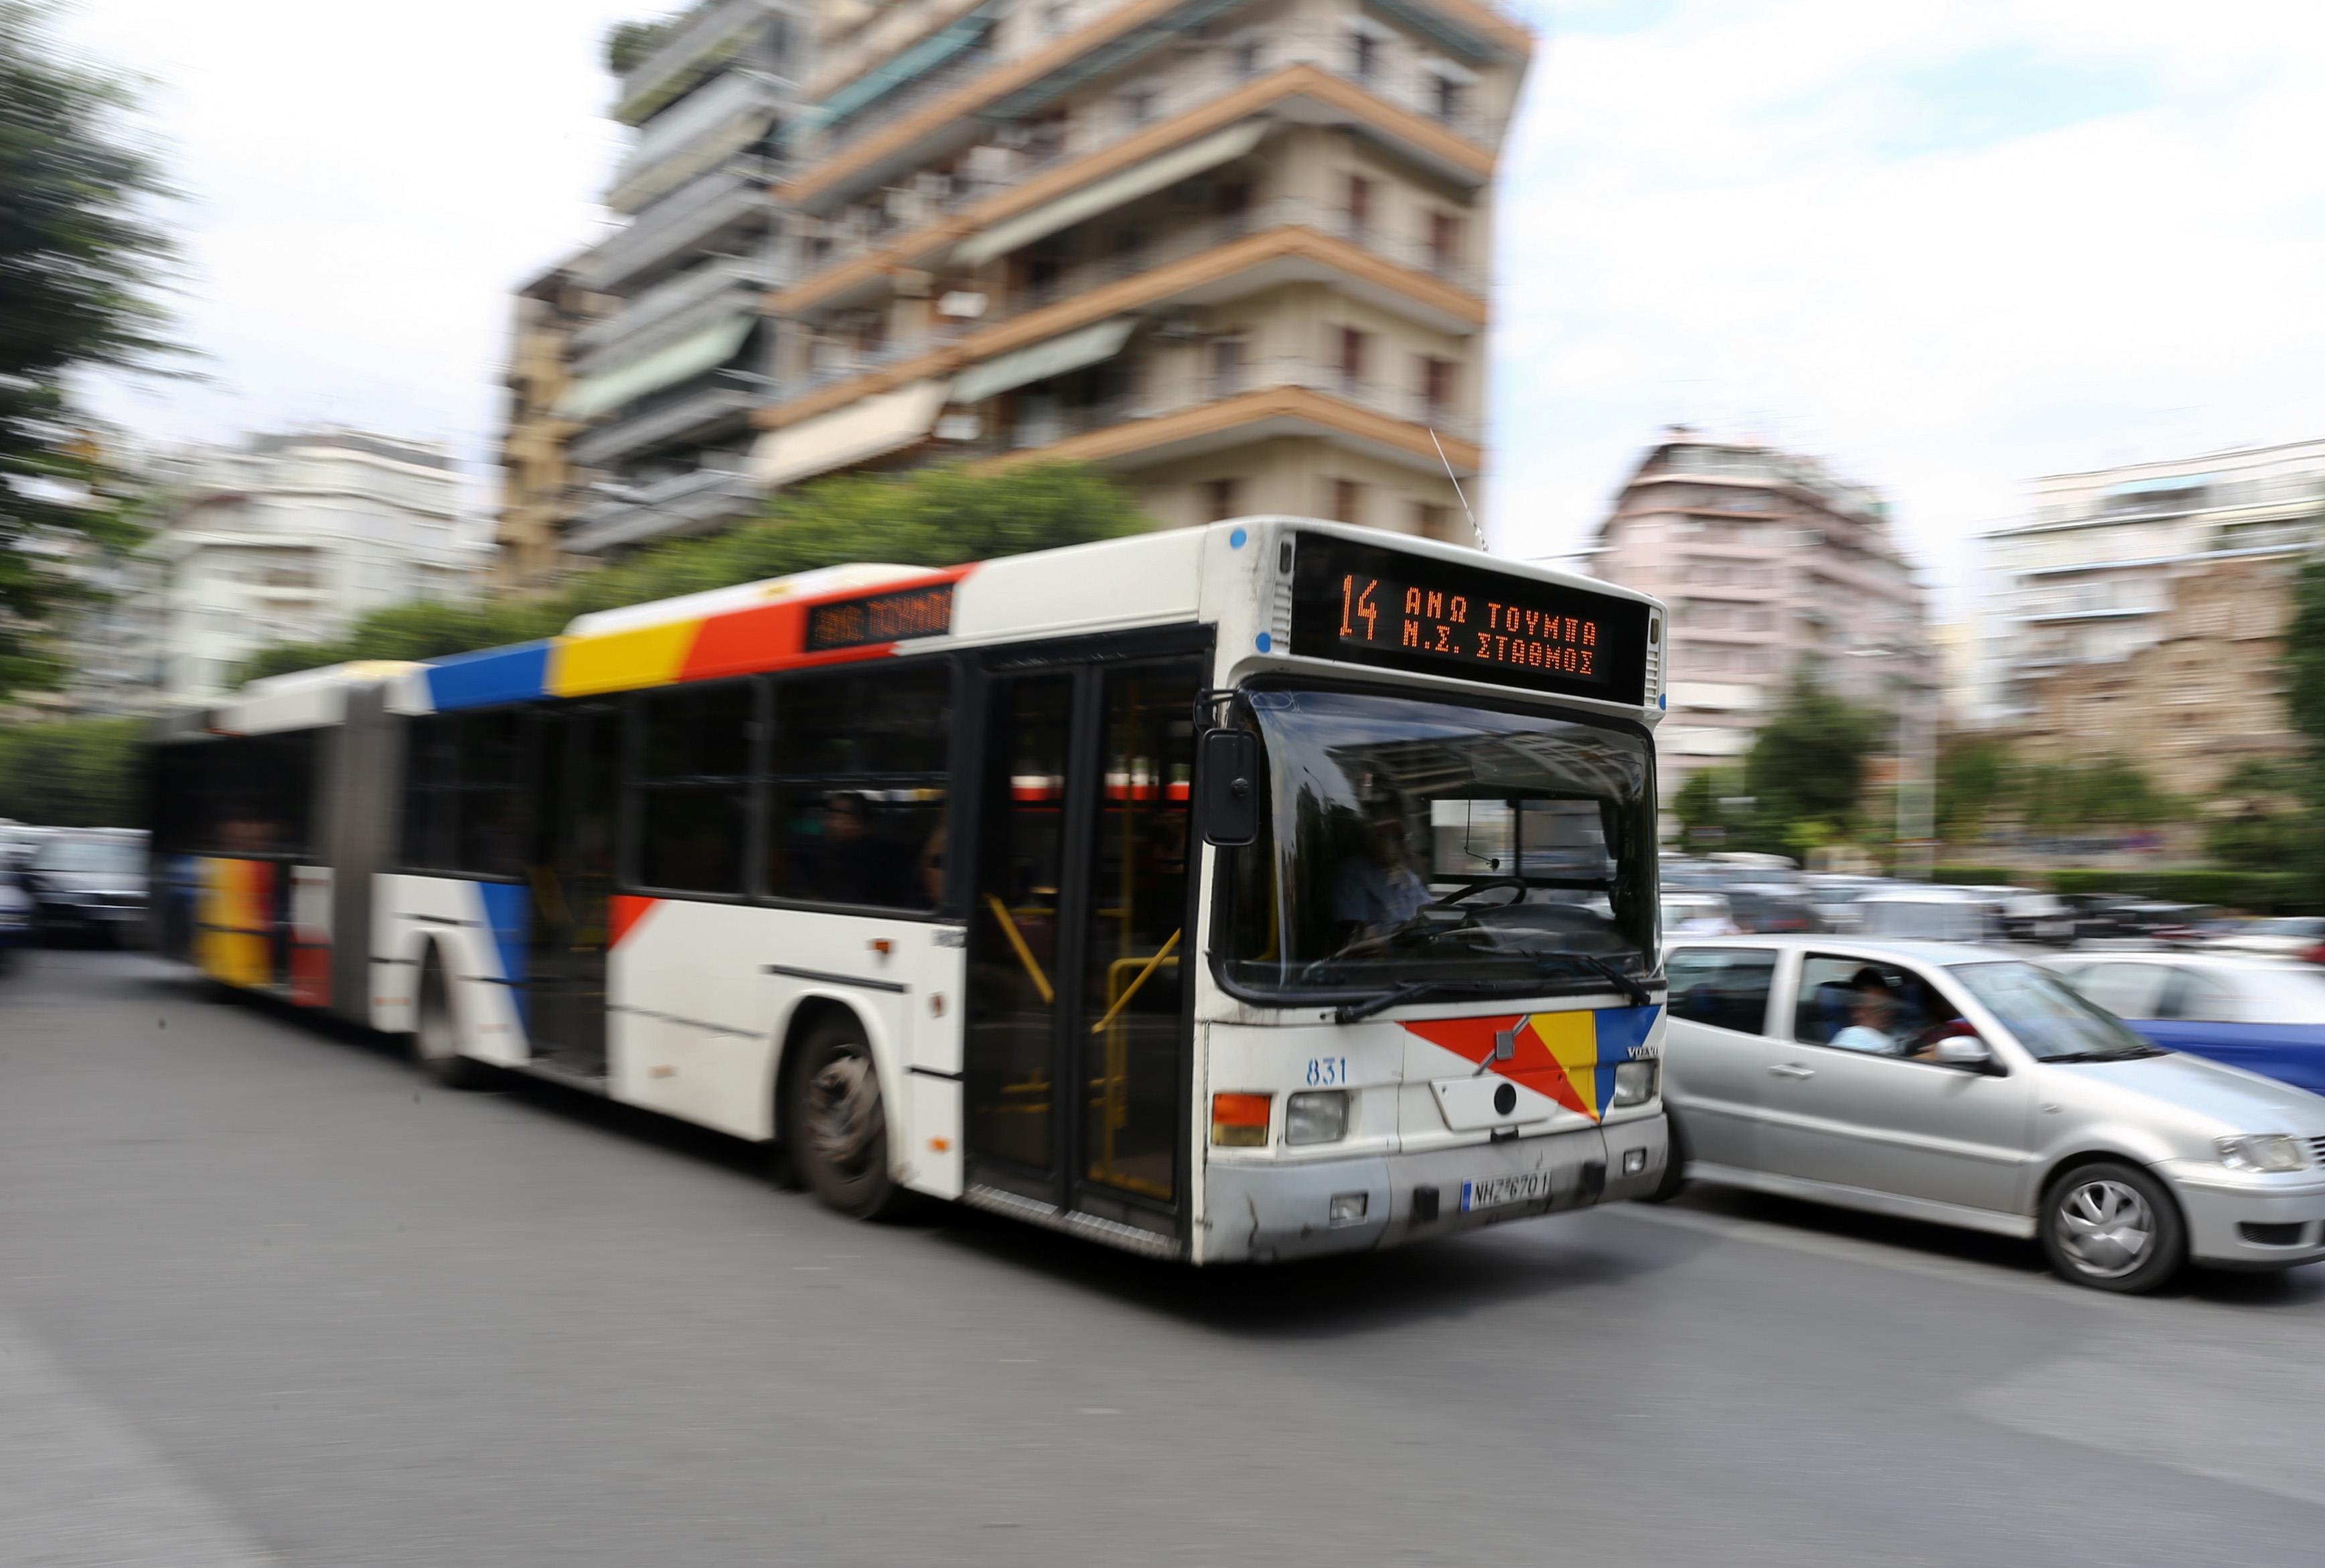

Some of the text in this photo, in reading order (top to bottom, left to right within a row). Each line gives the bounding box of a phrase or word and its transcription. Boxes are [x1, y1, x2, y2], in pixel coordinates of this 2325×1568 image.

[1340, 574, 1377, 641] 14
[1406, 586, 1596, 646] ΑΝΩ ΤΟΥΜΠΑ
[1403, 619, 1593, 675] Ν.Σ. ΣΤΑΘΜΟΣ
[1306, 1056, 1345, 1086] 831
